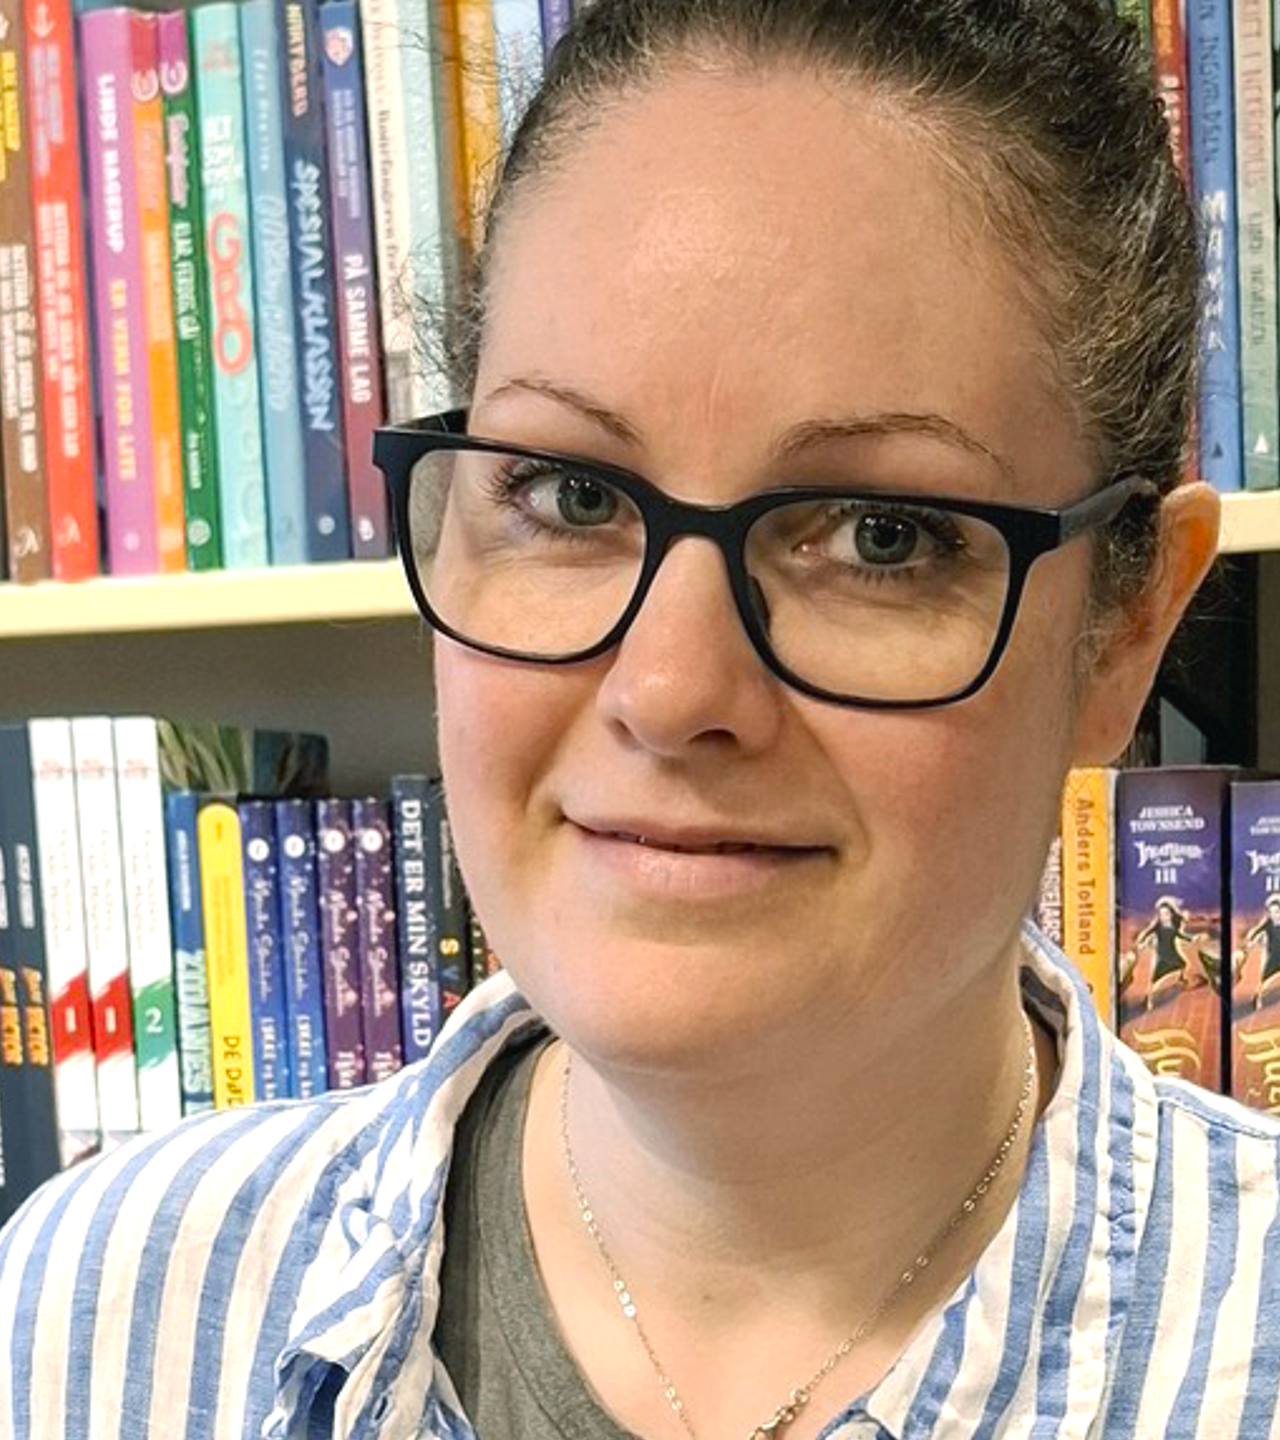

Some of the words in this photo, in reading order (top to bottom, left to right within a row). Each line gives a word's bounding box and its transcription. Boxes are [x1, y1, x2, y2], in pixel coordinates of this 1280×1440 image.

[97, 75, 119, 140] LINDE
[100, 150, 124, 252] HAGERUP
[343, 255, 369, 279] PÅ
[346, 287, 370, 356] SAMME
[350, 365, 371, 404] LAG
[117, 435, 136, 480] LITE
[401, 799, 424, 851] DET
[1129, 817, 1205, 833] TOWNSEND
[1138, 805, 1194, 821] JESSICA
[1074, 798, 1095, 883] Anders
[404, 860, 426, 893] ER
[406, 900, 429, 956] MIN
[1076, 886, 1098, 956] Totland
[144, 1008, 163, 1034] 2
[408, 961, 432, 1047] SKYLD
